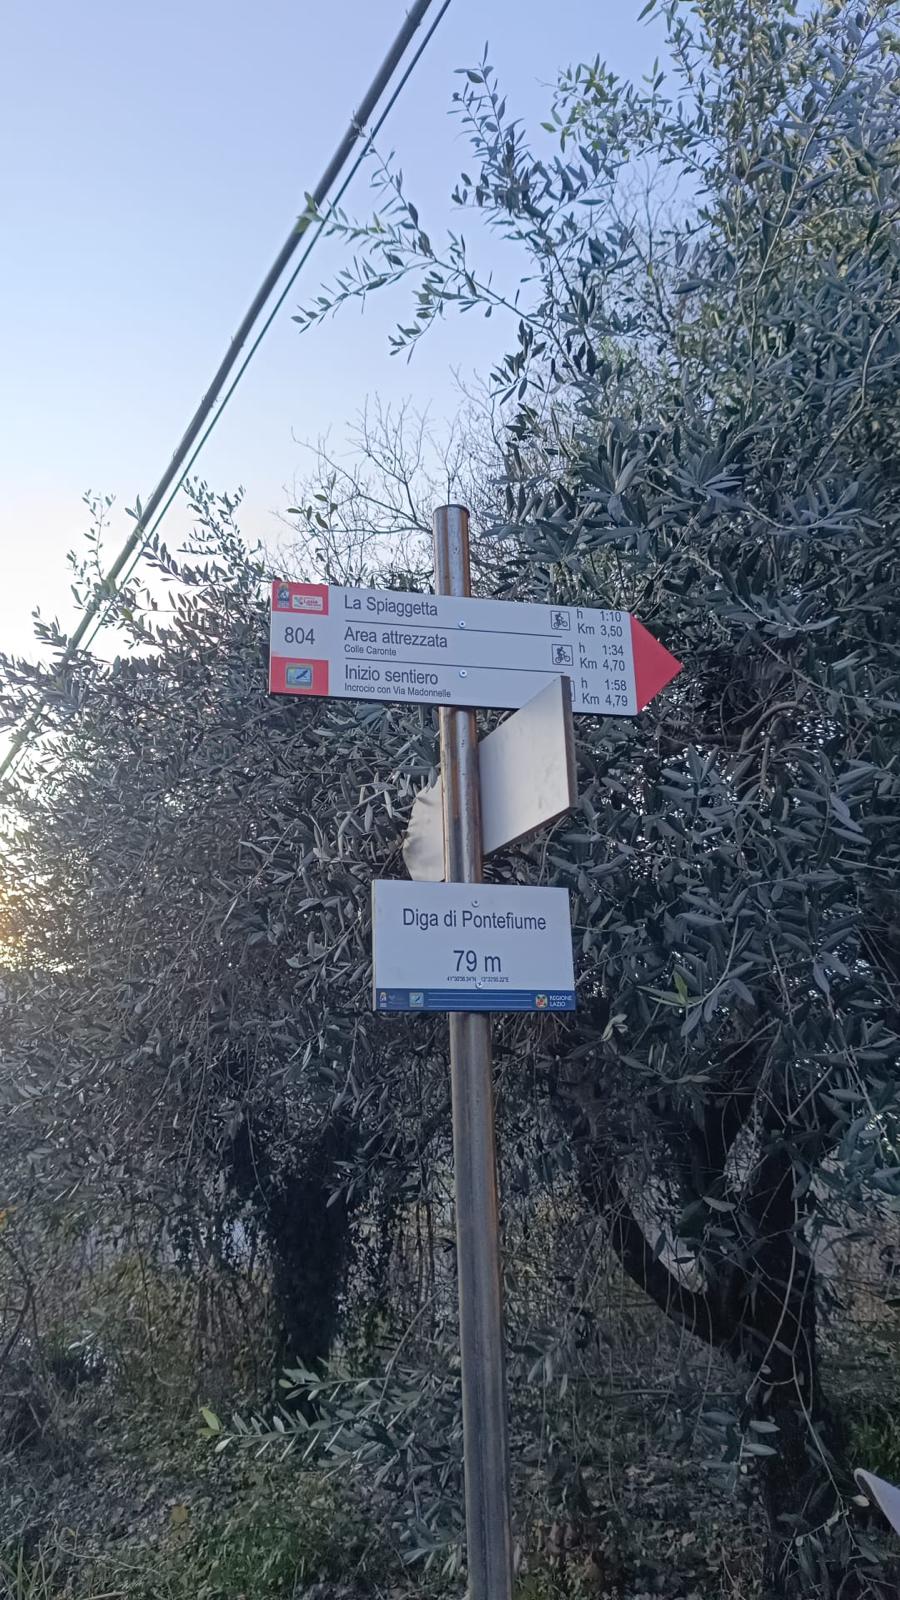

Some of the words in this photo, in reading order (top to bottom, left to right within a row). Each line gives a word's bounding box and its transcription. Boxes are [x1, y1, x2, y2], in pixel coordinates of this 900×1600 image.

[344, 594, 361, 610] La
[366, 596, 438, 617] Spiaggetta
[576, 608, 584, 619] h
[599, 611, 622, 622] 1:10
[284, 626, 316, 645] 804
[344, 626, 377, 643] Area
[382, 630, 448, 648] attrezzata
[577, 623, 596, 636] Km
[600, 625, 623, 638] 3,50
[344, 644, 364, 654] Colle
[366, 646, 397, 657] Caronte
[579, 642, 586, 653] h
[602, 645, 624, 656] 1:34
[580, 658, 598, 670] Km
[602, 660, 626, 673] 4,70
[345, 664, 380, 682] Inizio
[385, 669, 439, 686] sentiero
[344, 683, 375, 694] Incrocio
[393, 686, 406, 696] Via
[407, 687, 452, 699] Madonnelle
[581, 677, 588, 689] h
[604, 679, 627, 692] 1:58
[582, 693, 600, 706] Km
[605, 696, 628, 708] 4,79
[402, 908, 439, 931] Diga
[444, 910, 457, 928] di
[462, 910, 547, 931] Pontefiume
[453, 950, 478, 973] 79
[484, 955, 502, 973] m
